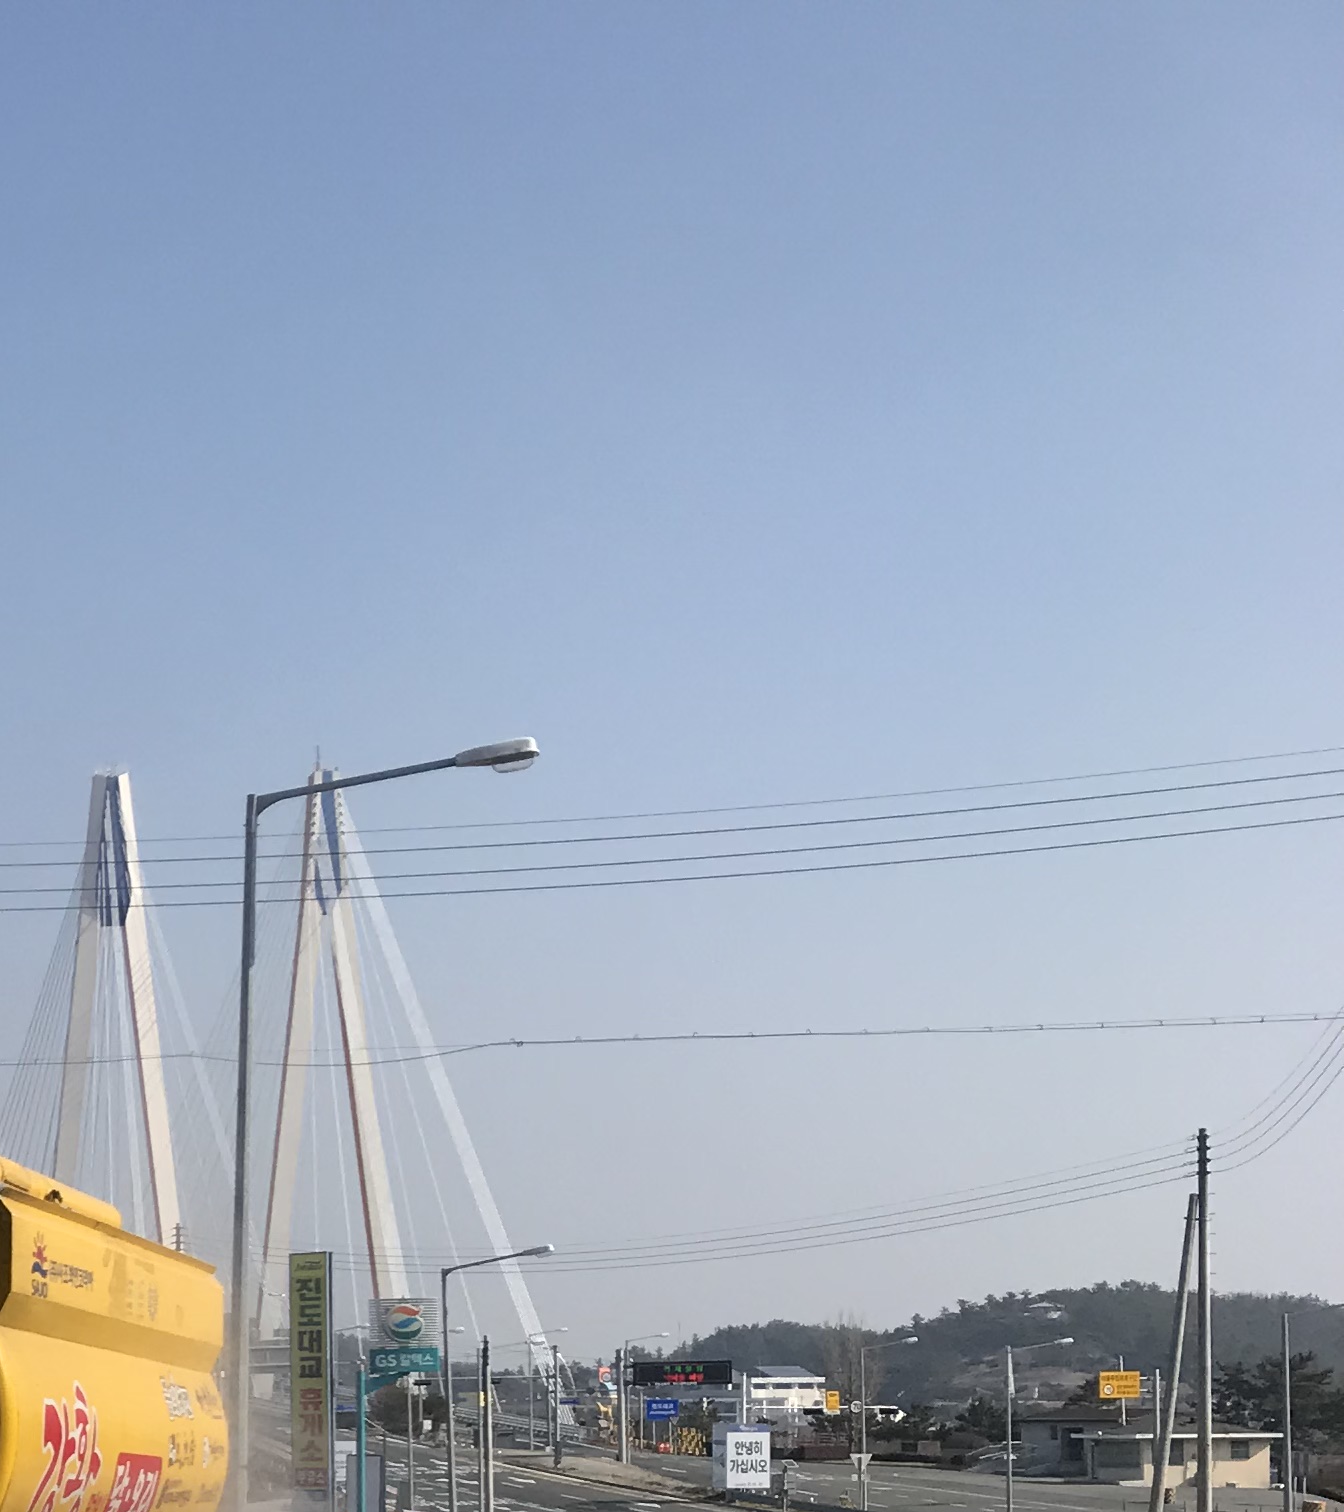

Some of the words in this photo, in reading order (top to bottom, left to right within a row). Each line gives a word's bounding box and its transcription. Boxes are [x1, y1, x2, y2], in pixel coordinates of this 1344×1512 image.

[295, 1277, 324, 1379] 진도대교
[374, 1354, 397, 1368] GS
[399, 1351, 435, 1367] 칼텍스
[734, 1440, 763, 1456] 안녕히
[729, 1458, 768, 1474] 가십시오
